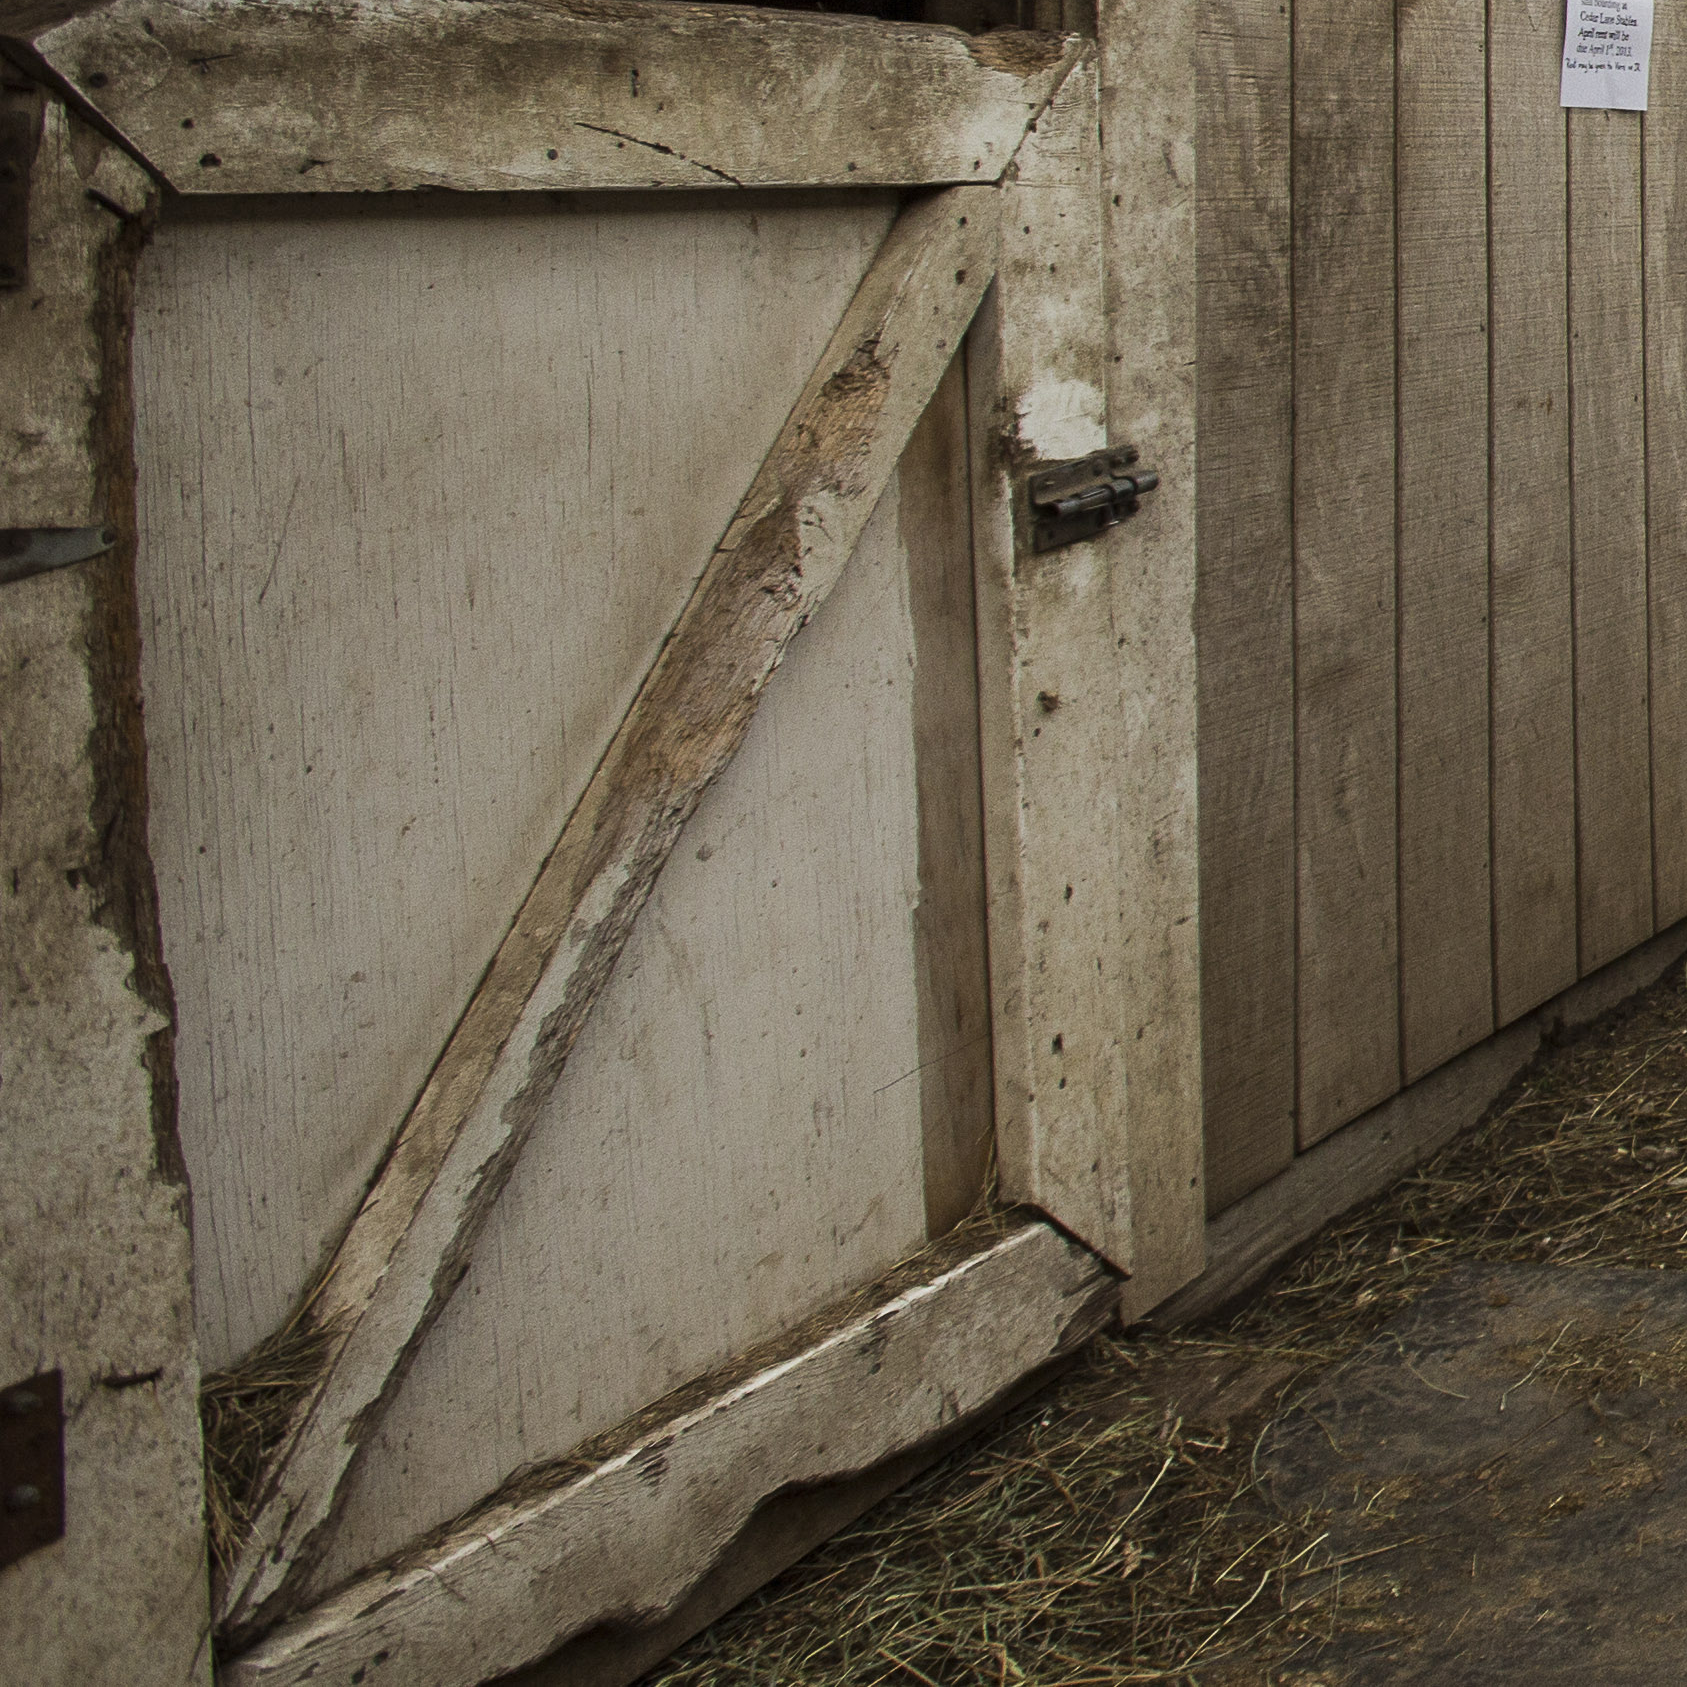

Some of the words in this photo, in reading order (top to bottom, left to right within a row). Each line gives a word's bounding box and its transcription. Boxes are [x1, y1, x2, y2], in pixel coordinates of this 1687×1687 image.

[1580, 11, 1599, 23] Cedar
[1599, 12, 1615, 24] Lane
[1577, 27, 1595, 41] April
[1595, 30, 1608, 39] rent
[1609, 29, 1621, 41] will
[1622, 30, 1629, 41] be
[1576, 42, 1588, 53] due
[1589, 43, 1605, 57] April
